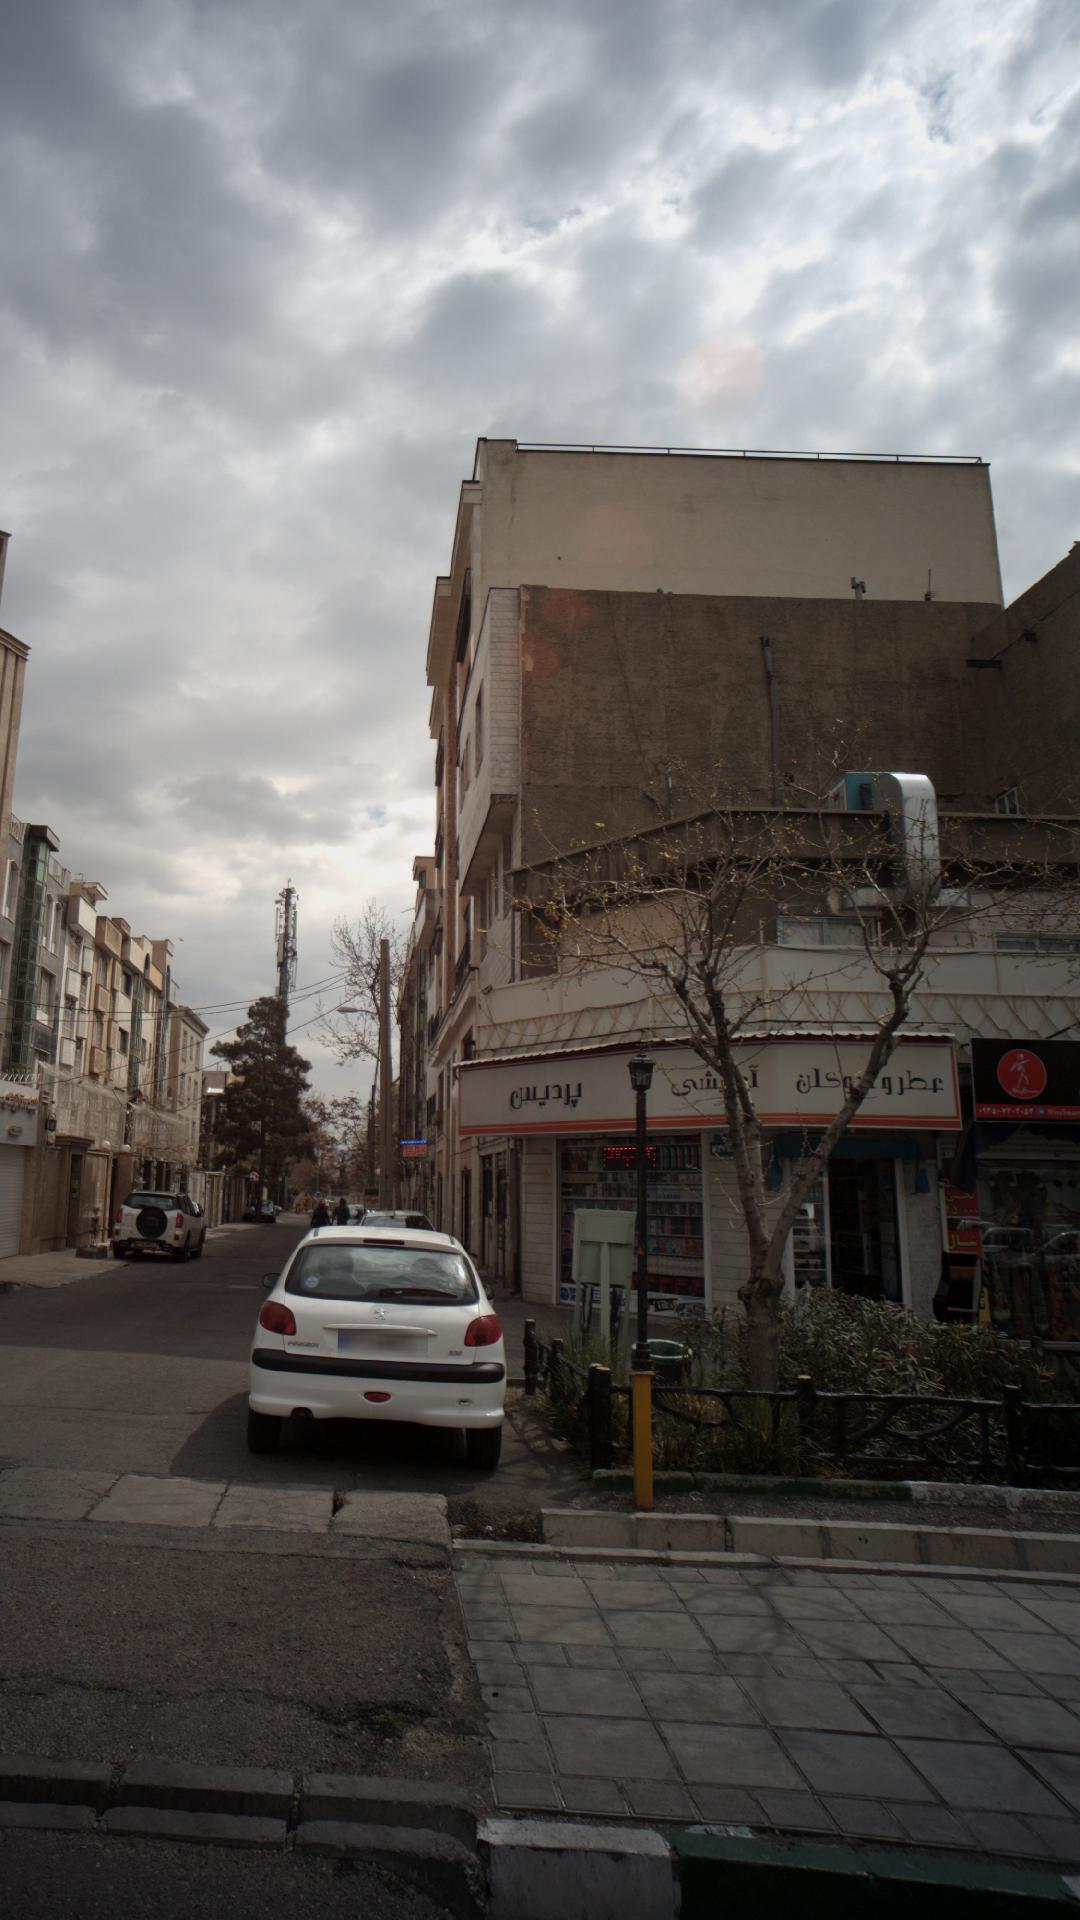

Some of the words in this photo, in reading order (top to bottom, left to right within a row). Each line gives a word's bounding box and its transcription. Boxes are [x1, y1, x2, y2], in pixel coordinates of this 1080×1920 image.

[796, 1067, 876, 1095] وکلن
[881, 1075, 893, 1095] و
[896, 1069, 944, 1096] عطر
[509, 1081, 584, 1110] پردیس
